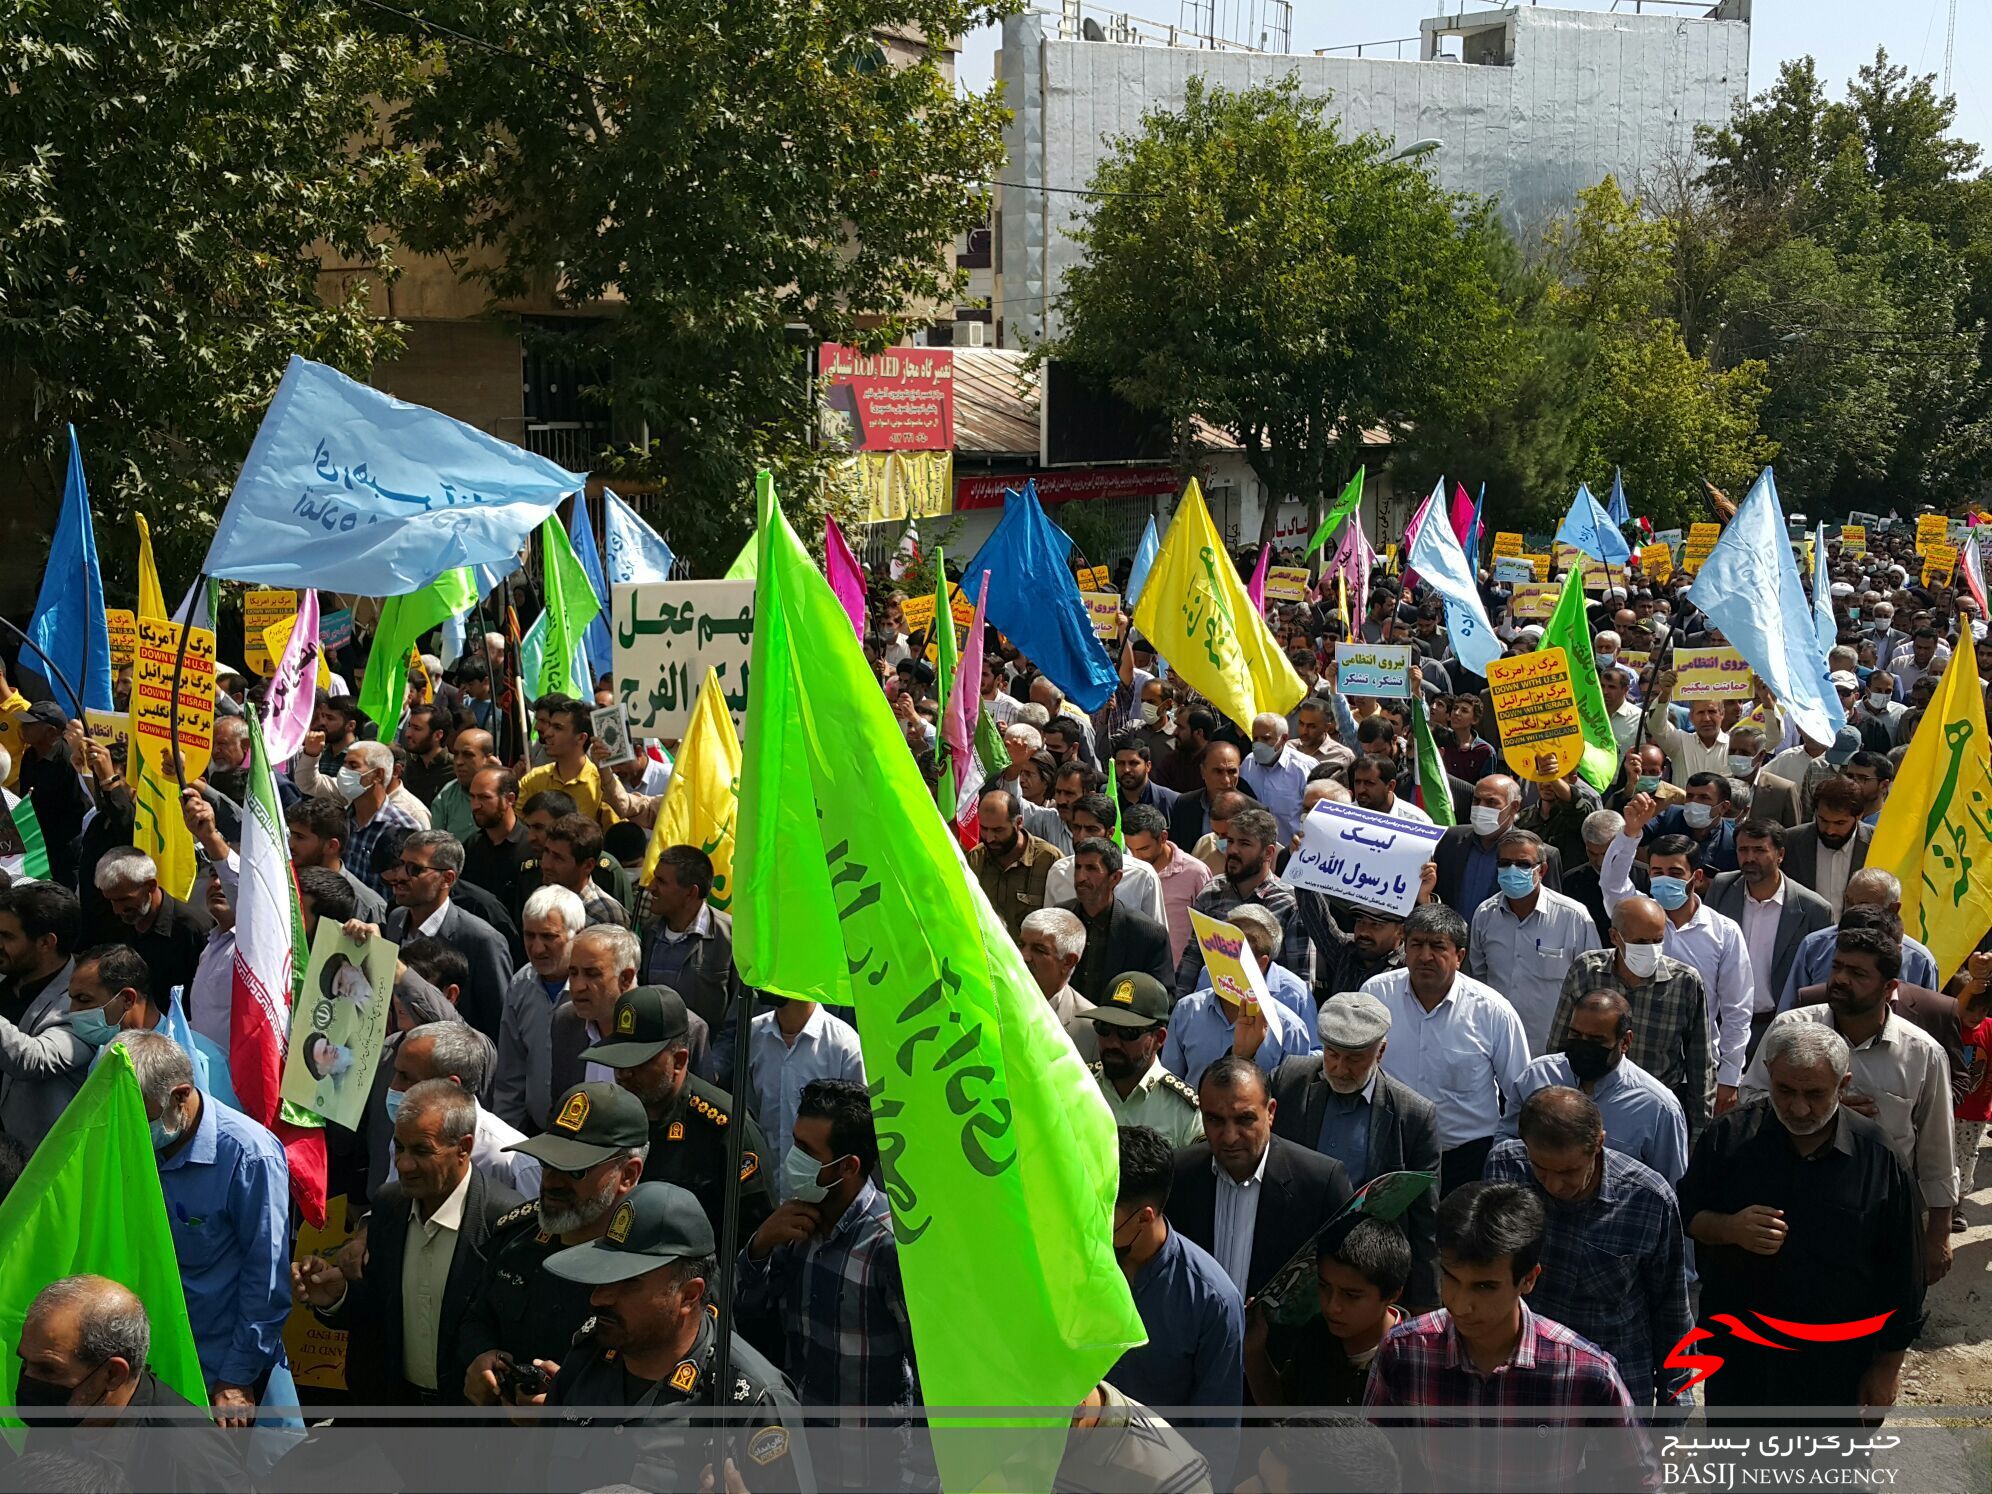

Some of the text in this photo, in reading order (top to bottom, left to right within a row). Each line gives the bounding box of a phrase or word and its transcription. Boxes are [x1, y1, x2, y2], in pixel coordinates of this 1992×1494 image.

[879, 356, 899, 377] LED
[619, 588, 696, 649] عجل
[139, 623, 212, 658] مرگ آمریکا
[141, 648, 168, 662] DOWN
[1341, 652, 1406, 670] نیروی انتظامی
[1676, 656, 1719, 672] انتظامی
[139, 662, 212, 694] مرگ بر سرائیل
[1342, 674, 1369, 686] تشکر
[1494, 658, 1558, 680] مرگ بر امریکا
[620, 660, 689, 729] الفرج
[1494, 682, 1520, 694] DOWN
[1522, 678, 1541, 689] WITH
[1498, 684, 1567, 709] مرگ بر اسرائیل
[1680, 681, 1710, 694] میکنیم
[141, 686, 166, 698] DOWN
[186, 696, 211, 710] ISRAEL
[1499, 699, 1571, 719] DOWN WITH ISRAEL
[138, 703, 169, 719] نگلیس
[188, 714, 211, 732] مرگ
[1504, 712, 1573, 736] مرگ بر انگلیس
[140, 723, 160, 734] DOWN
[178, 732, 209, 747] ENGLAND
[1339, 826, 1397, 853] لبیک
[1298, 849, 1406, 900] یا رسول الله (ص)
